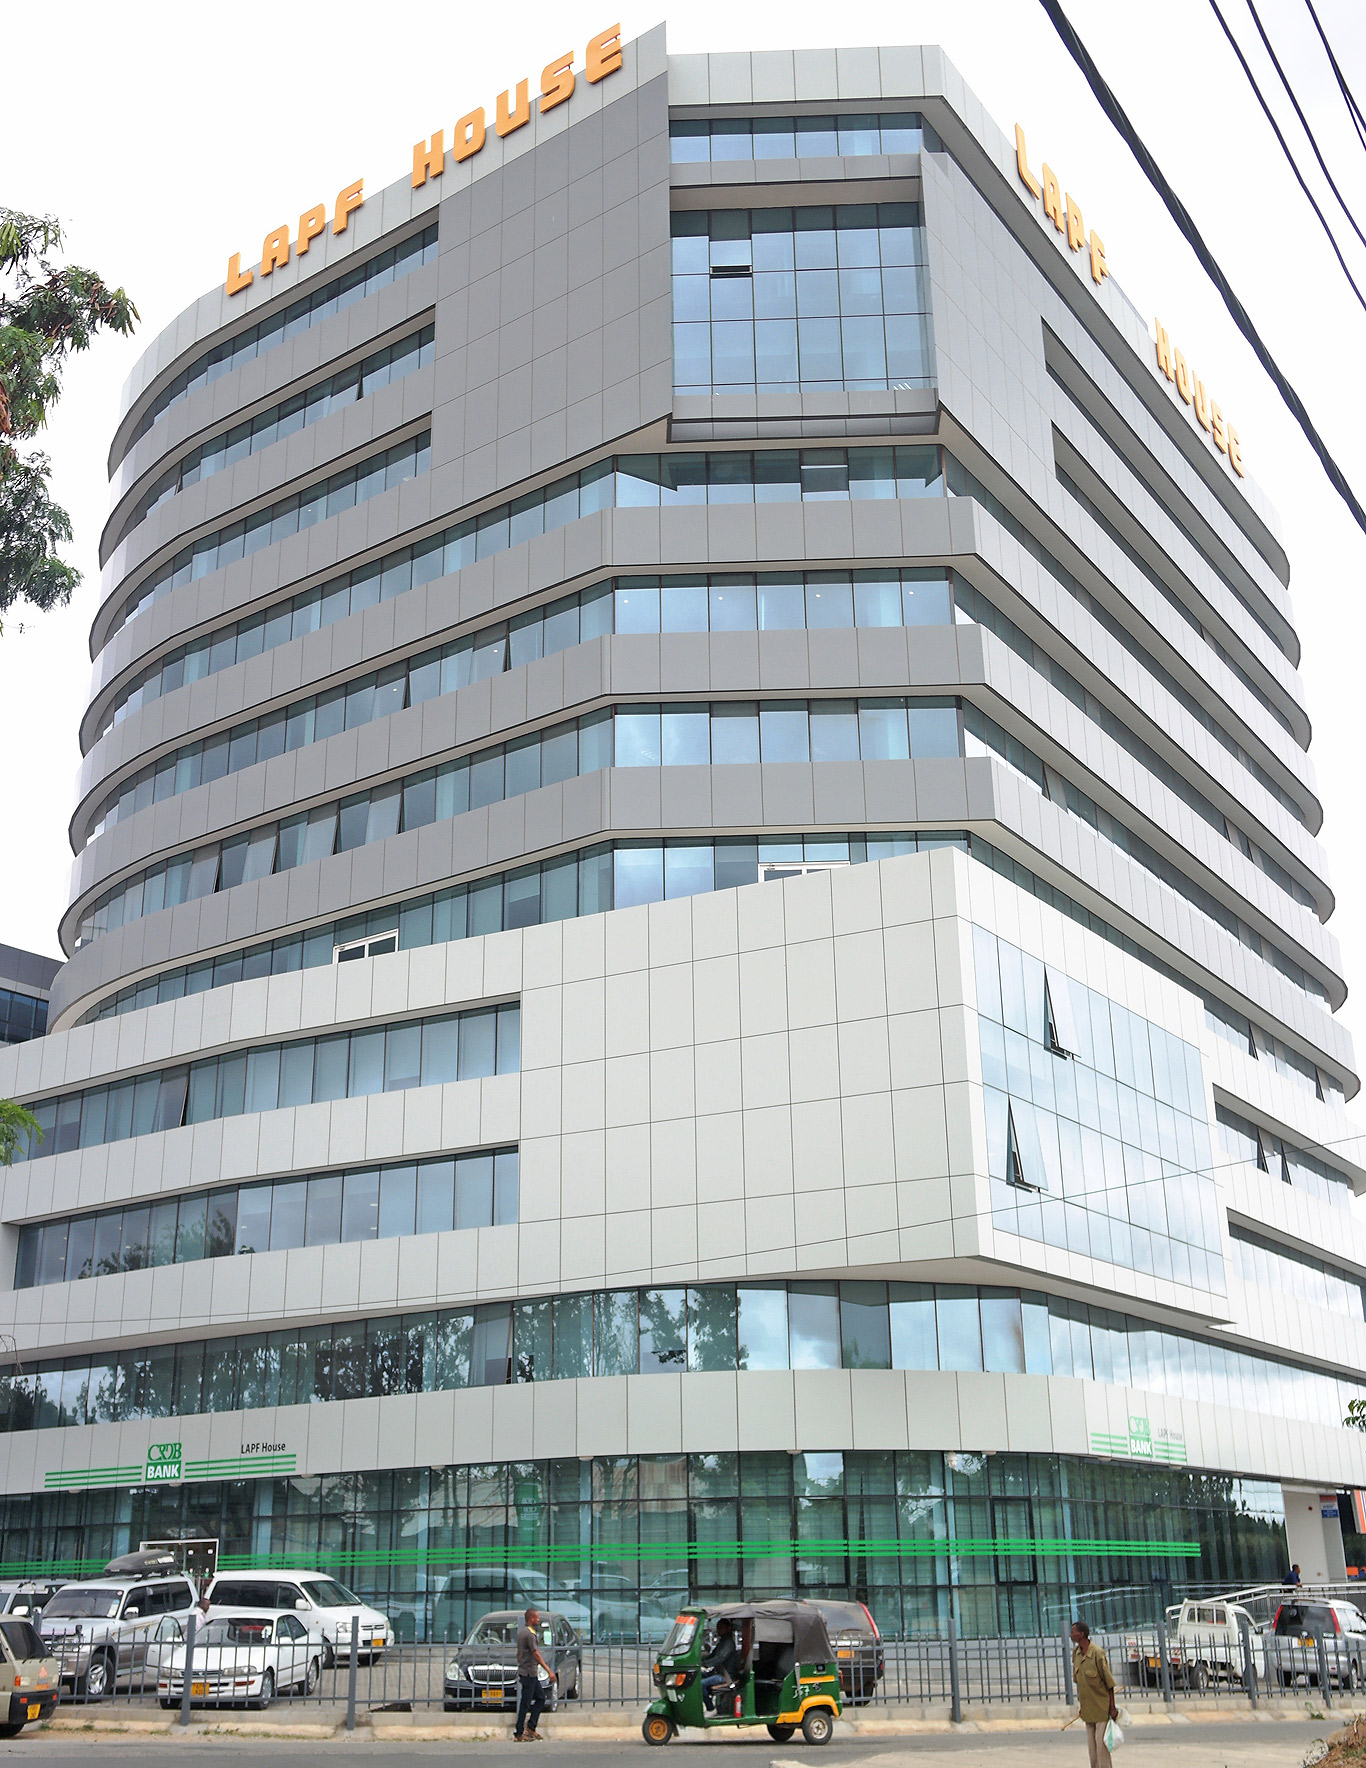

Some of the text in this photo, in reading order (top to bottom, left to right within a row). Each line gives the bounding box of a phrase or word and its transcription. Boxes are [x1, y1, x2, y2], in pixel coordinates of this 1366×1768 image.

[226, 22, 623, 296] LAPF HOUSE
[1015, 123, 1244, 479] LAPF HOUSE
[147, 1443, 182, 1461] CRDB
[241, 1442, 286, 1454] LAPF House
[1130, 1439, 1152, 1455] BANK
[147, 1464, 180, 1479] BANK
